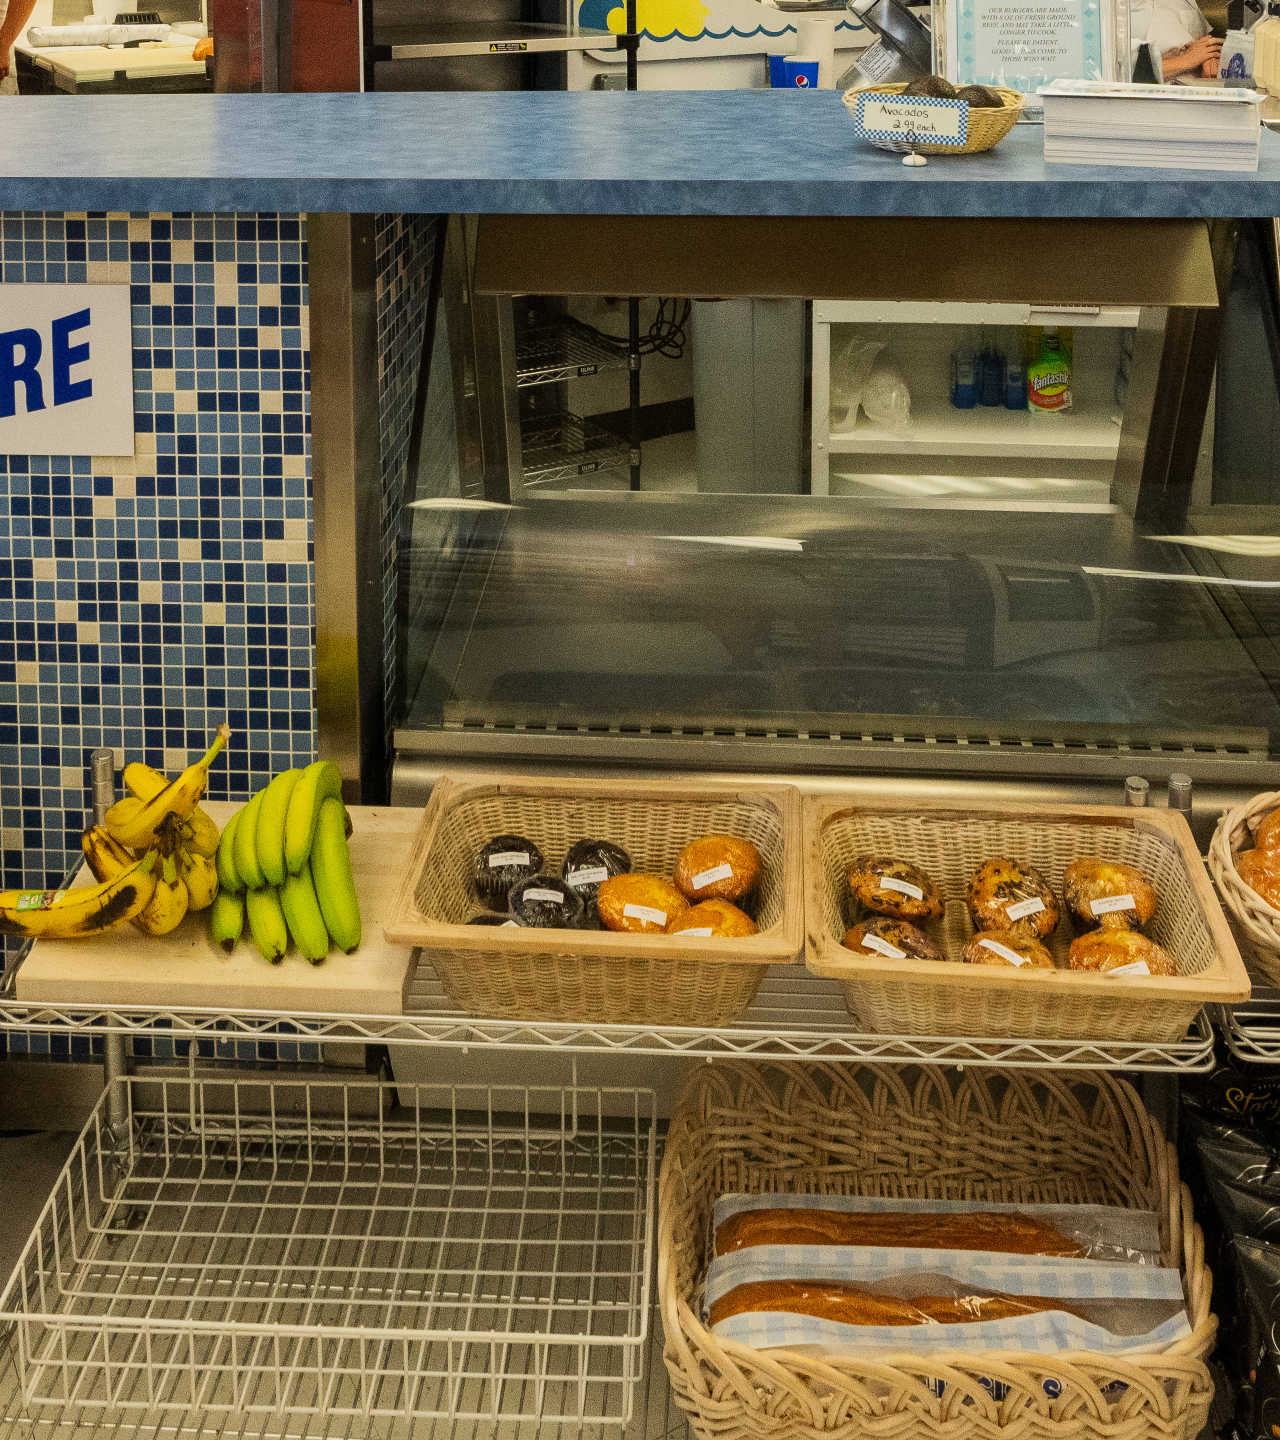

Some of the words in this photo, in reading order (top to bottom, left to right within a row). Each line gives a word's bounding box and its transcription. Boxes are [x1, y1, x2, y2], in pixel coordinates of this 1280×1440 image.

[880, 104, 930, 120] Avocados
[893, 119, 916, 131] 2.99
[917, 122, 937, 133] each
